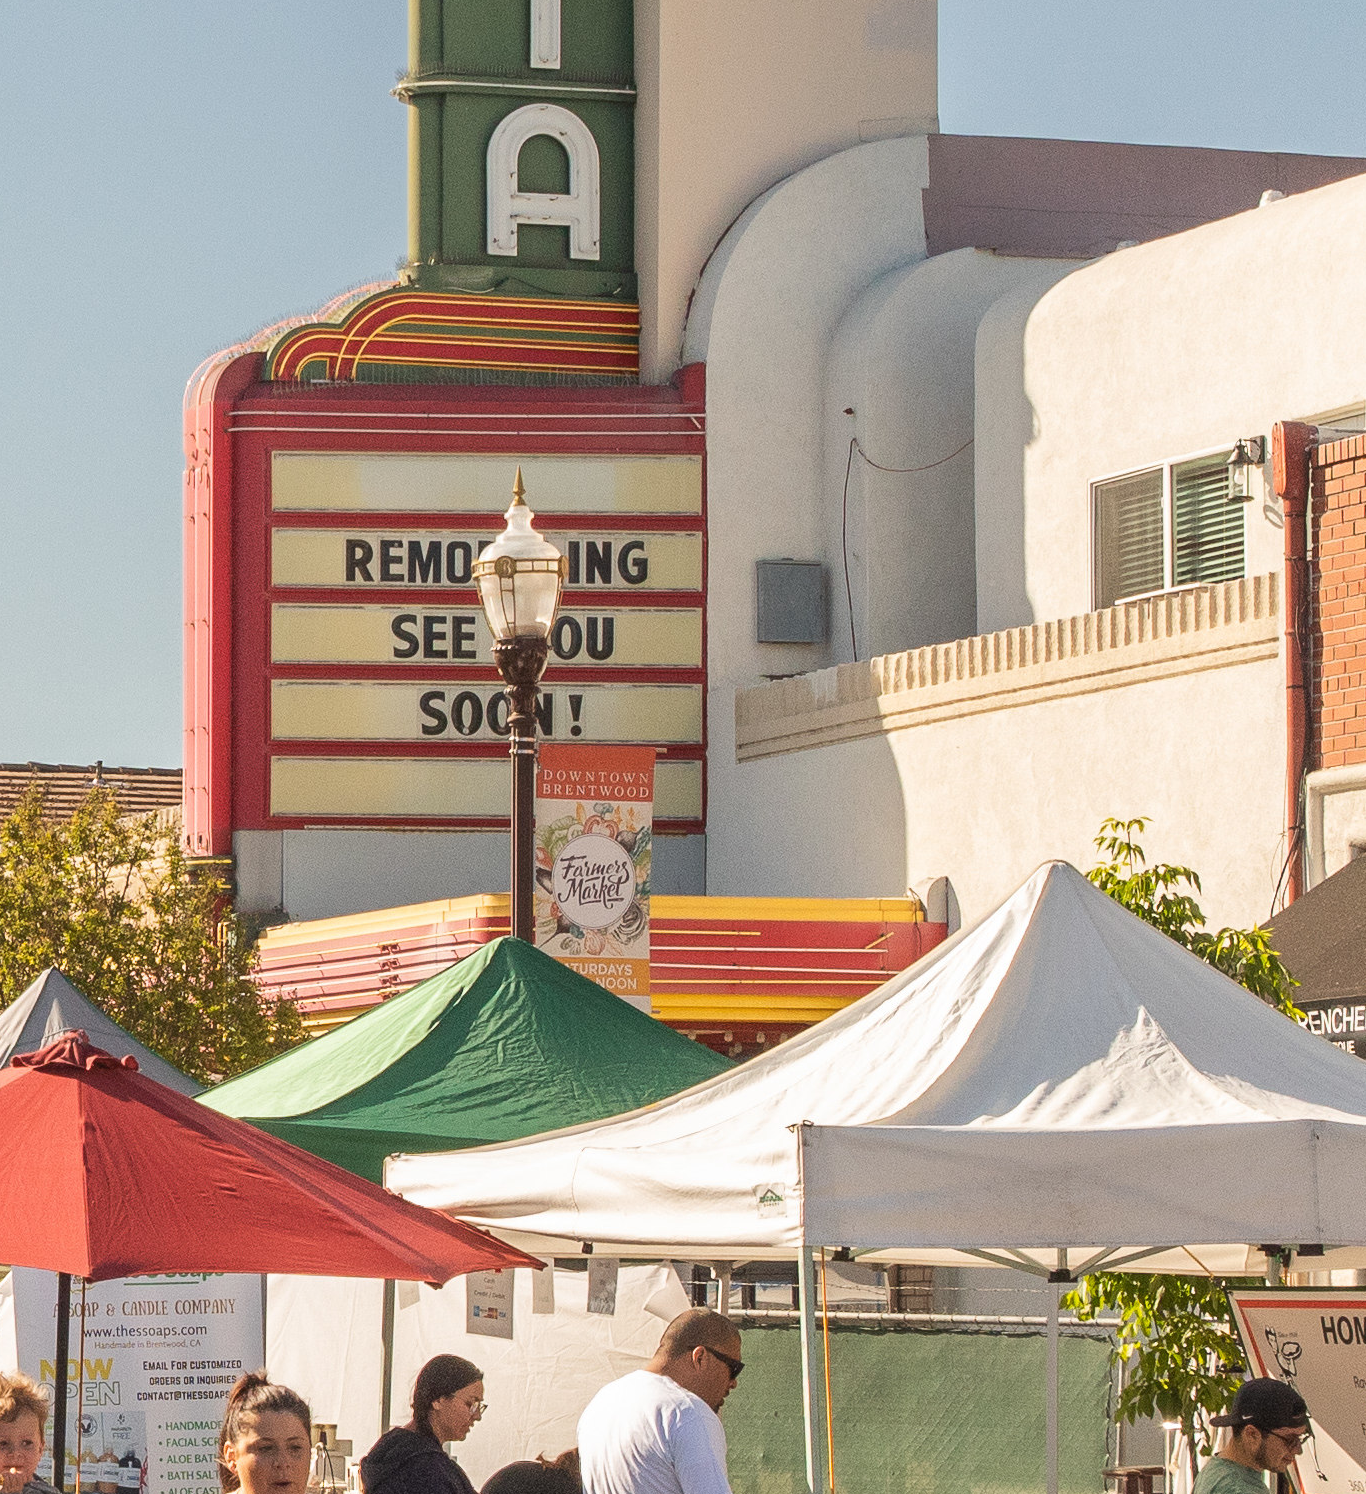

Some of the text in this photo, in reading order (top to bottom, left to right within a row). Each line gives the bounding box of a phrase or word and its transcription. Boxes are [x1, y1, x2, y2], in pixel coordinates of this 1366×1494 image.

[345, 538, 649, 586] REMOING
[391, 614, 615, 661] SEE OU
[543, 769, 650, 784] DOWNTOWN
[542, 783, 650, 798] BRENTWOOD
[559, 855, 630, 885] Farmers
[557, 875, 626, 909] Market
[565, 962, 633, 976] TURDAYS
[106, 1303, 115, 1317] &
[122, 1300, 168, 1317] CANDLE
[175, 1298, 235, 1315] COMPANY
[84, 1324, 207, 1340] www.thessoaps.com
[40, 1357, 113, 1382] NOW
[166, 1437, 220, 1447] FACIAL SCR
[167, 1454, 192, 1464] ALOE
[167, 1471, 194, 1481] BATH
